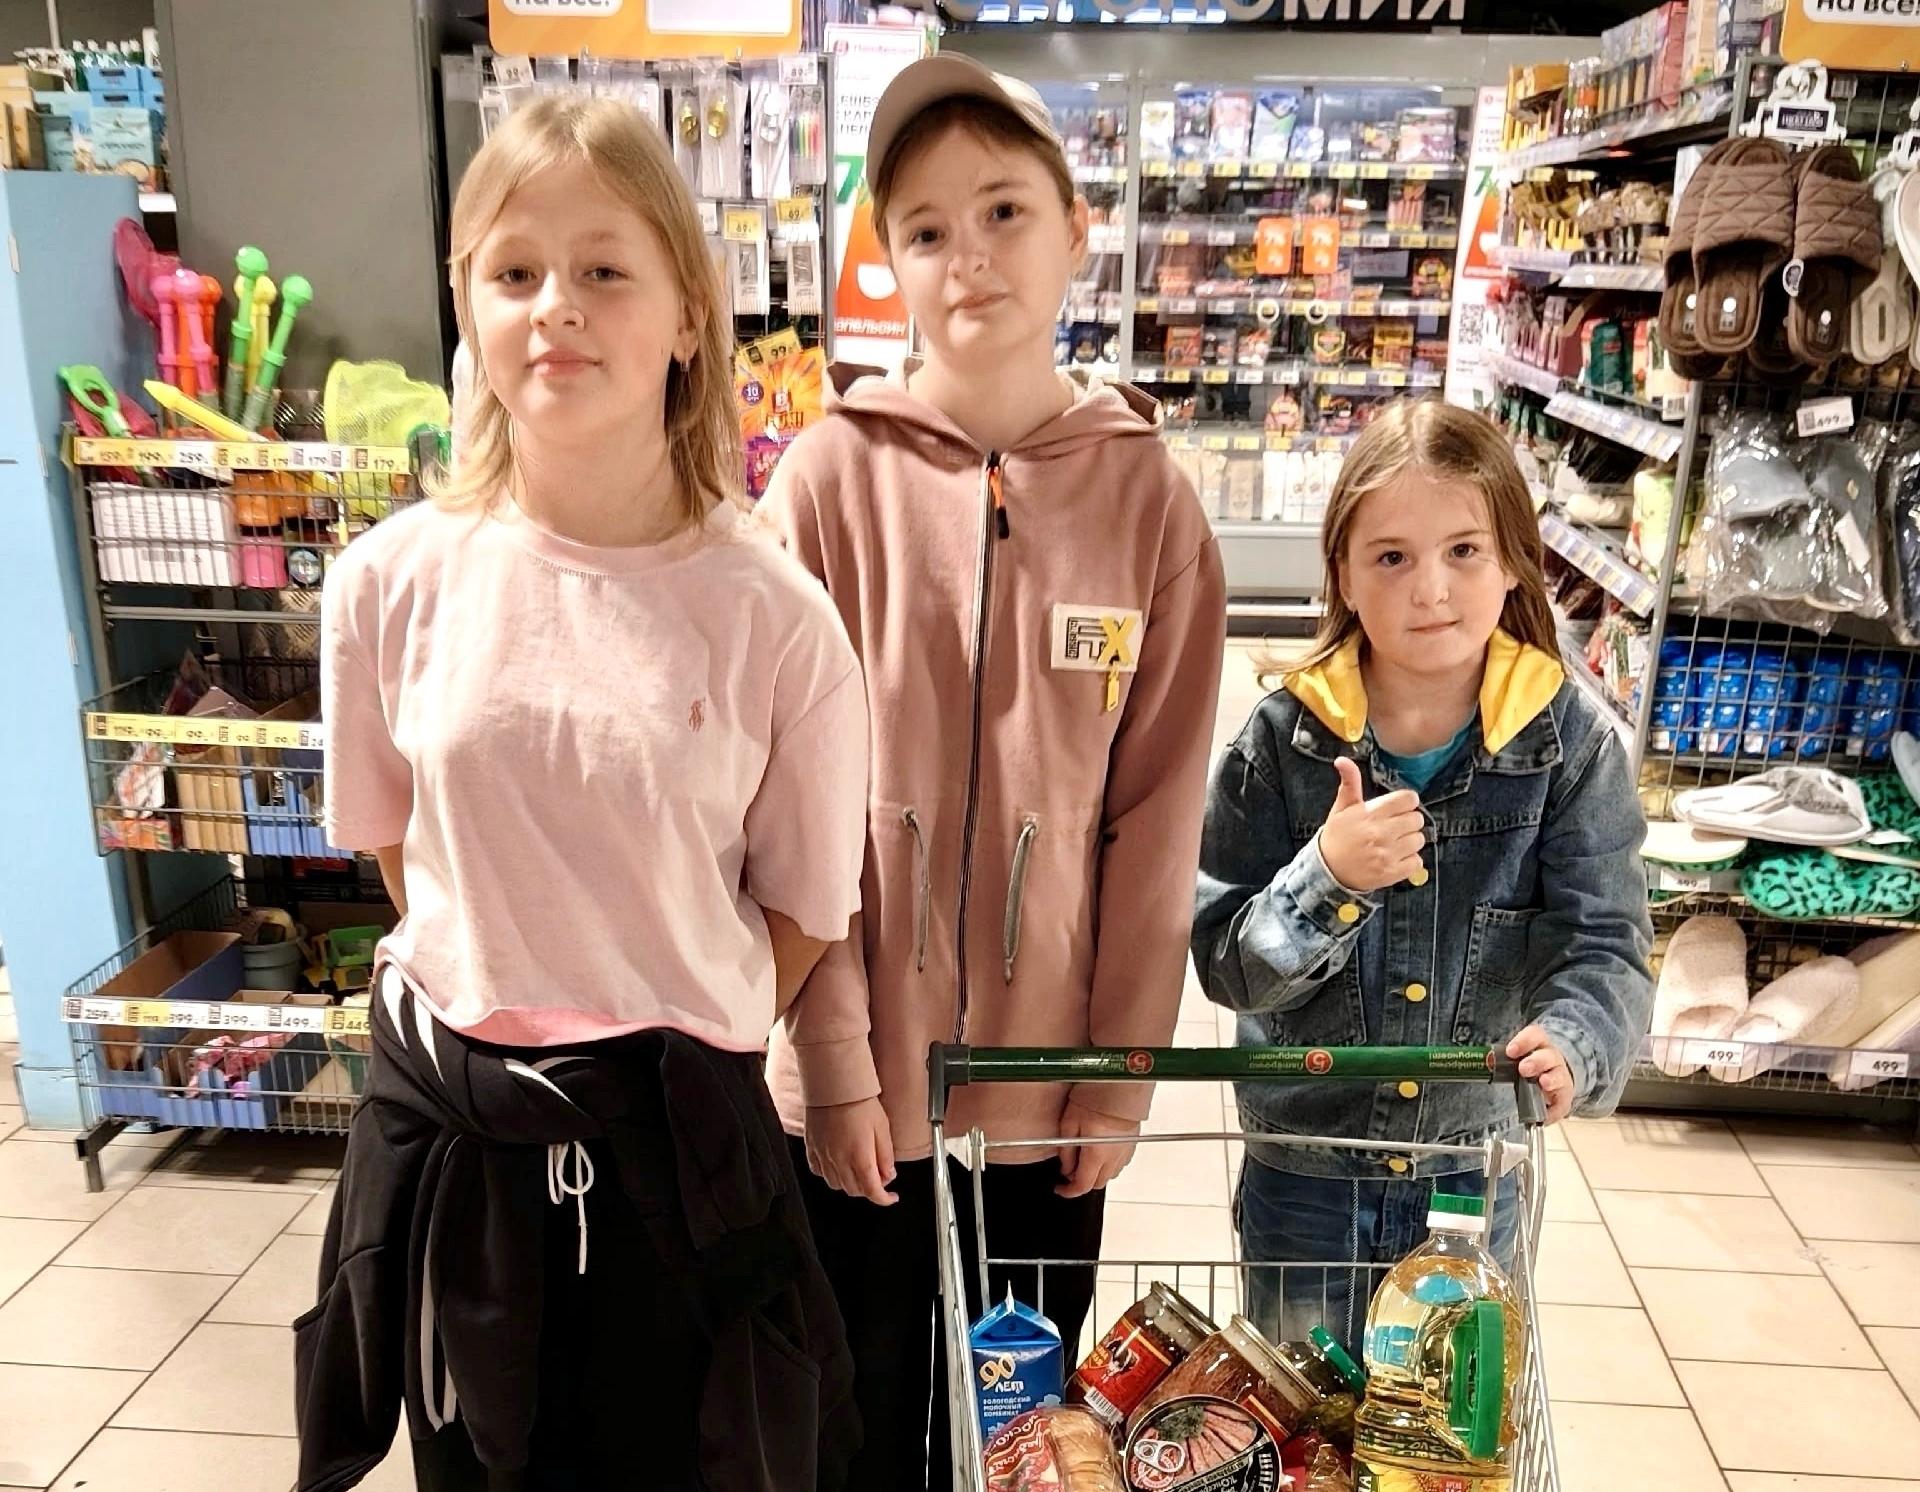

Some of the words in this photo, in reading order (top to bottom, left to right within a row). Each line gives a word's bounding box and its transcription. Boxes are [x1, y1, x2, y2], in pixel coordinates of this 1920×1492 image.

[223, 1015, 249, 1025] 399
[283, 1017, 310, 1028] 499
[1707, 1050, 1735, 1062] 499
[1872, 1060, 1900, 1073] 499
[980, 1353, 1016, 1391] 90
